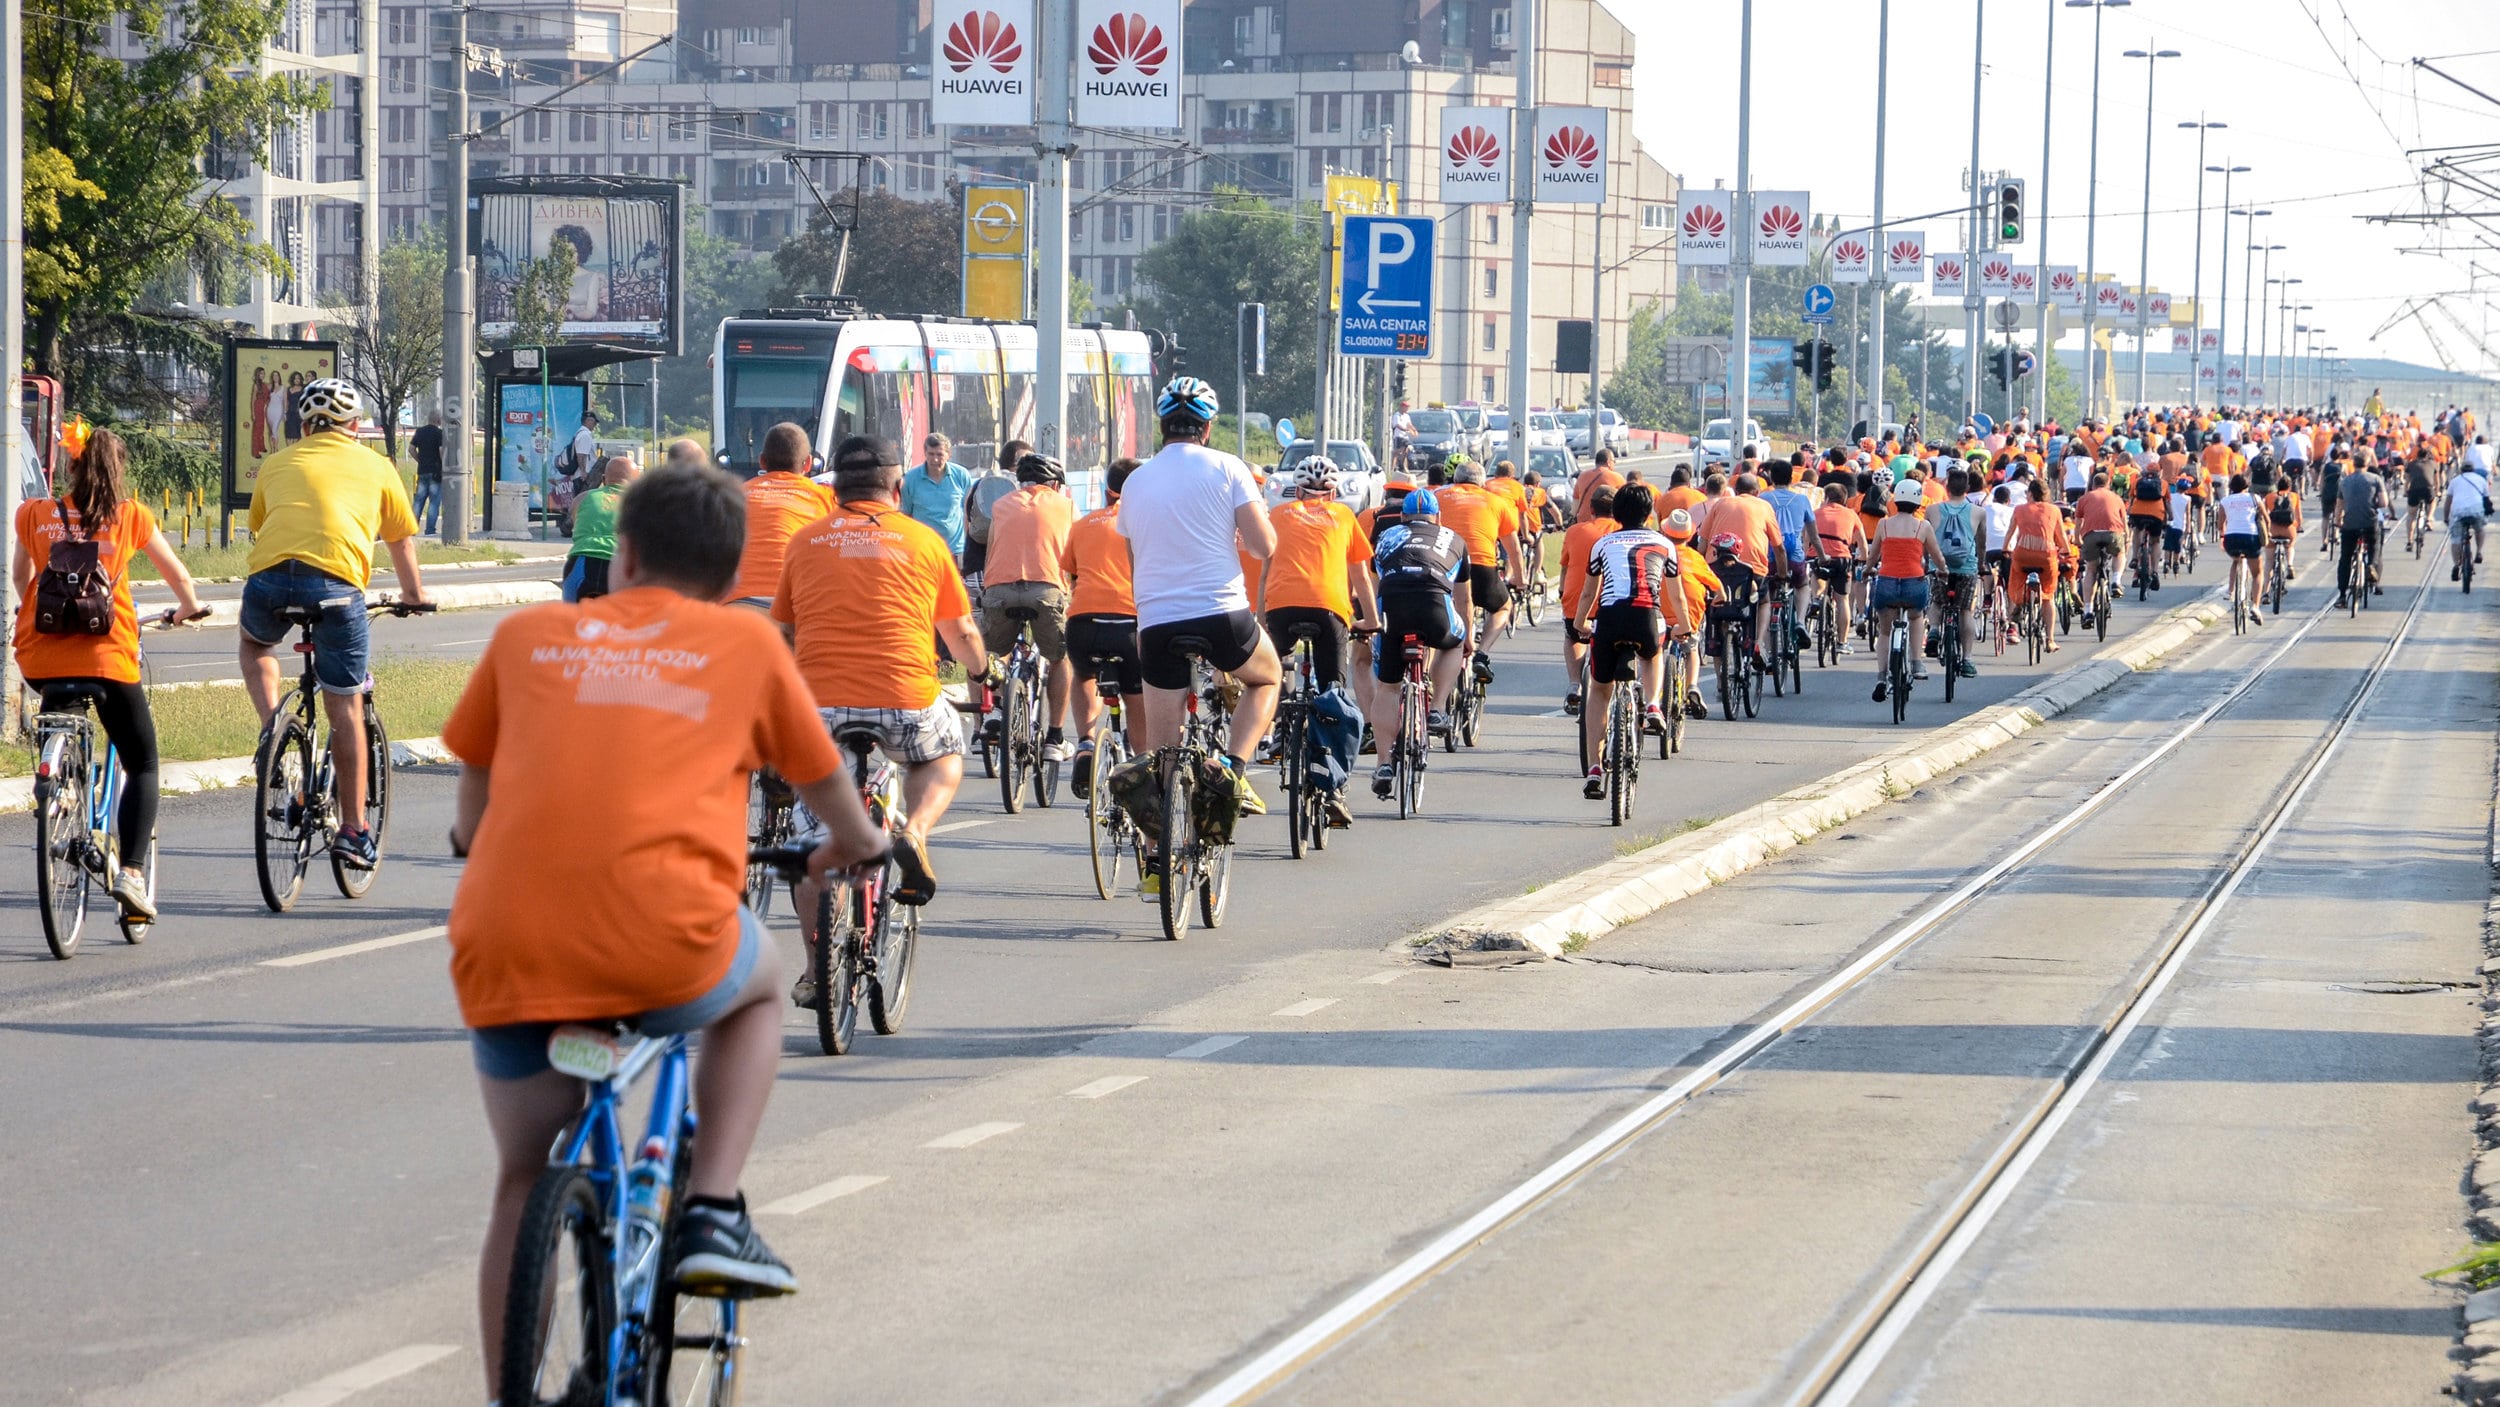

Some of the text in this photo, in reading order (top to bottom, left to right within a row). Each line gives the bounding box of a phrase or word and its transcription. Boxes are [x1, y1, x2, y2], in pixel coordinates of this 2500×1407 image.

[941, 79, 1022, 95] HUAWEI
[1086, 81, 1168, 97] HUAWEI
[1446, 172, 1500, 182] HUAWEI
[1543, 173, 1598, 183] HUAWEI
[535, 203, 603, 219] ДИВНА
[1682, 241, 1725, 249] HUAWEI
[1759, 241, 1803, 249] HUAWEI
[1367, 222, 1416, 289] P
[1345, 317, 1427, 331] SAVA CENTAR
[1344, 333, 1428, 350] SLOBODNO 334
[509, 412, 529, 420] EXIT
[48, 531, 56, 539] U
[810, 530, 905, 545] NAJVAŽNIJI POZIV
[530, 646, 709, 670] NAJVAŽNIJI POZIV
[562, 662, 578, 680] U
